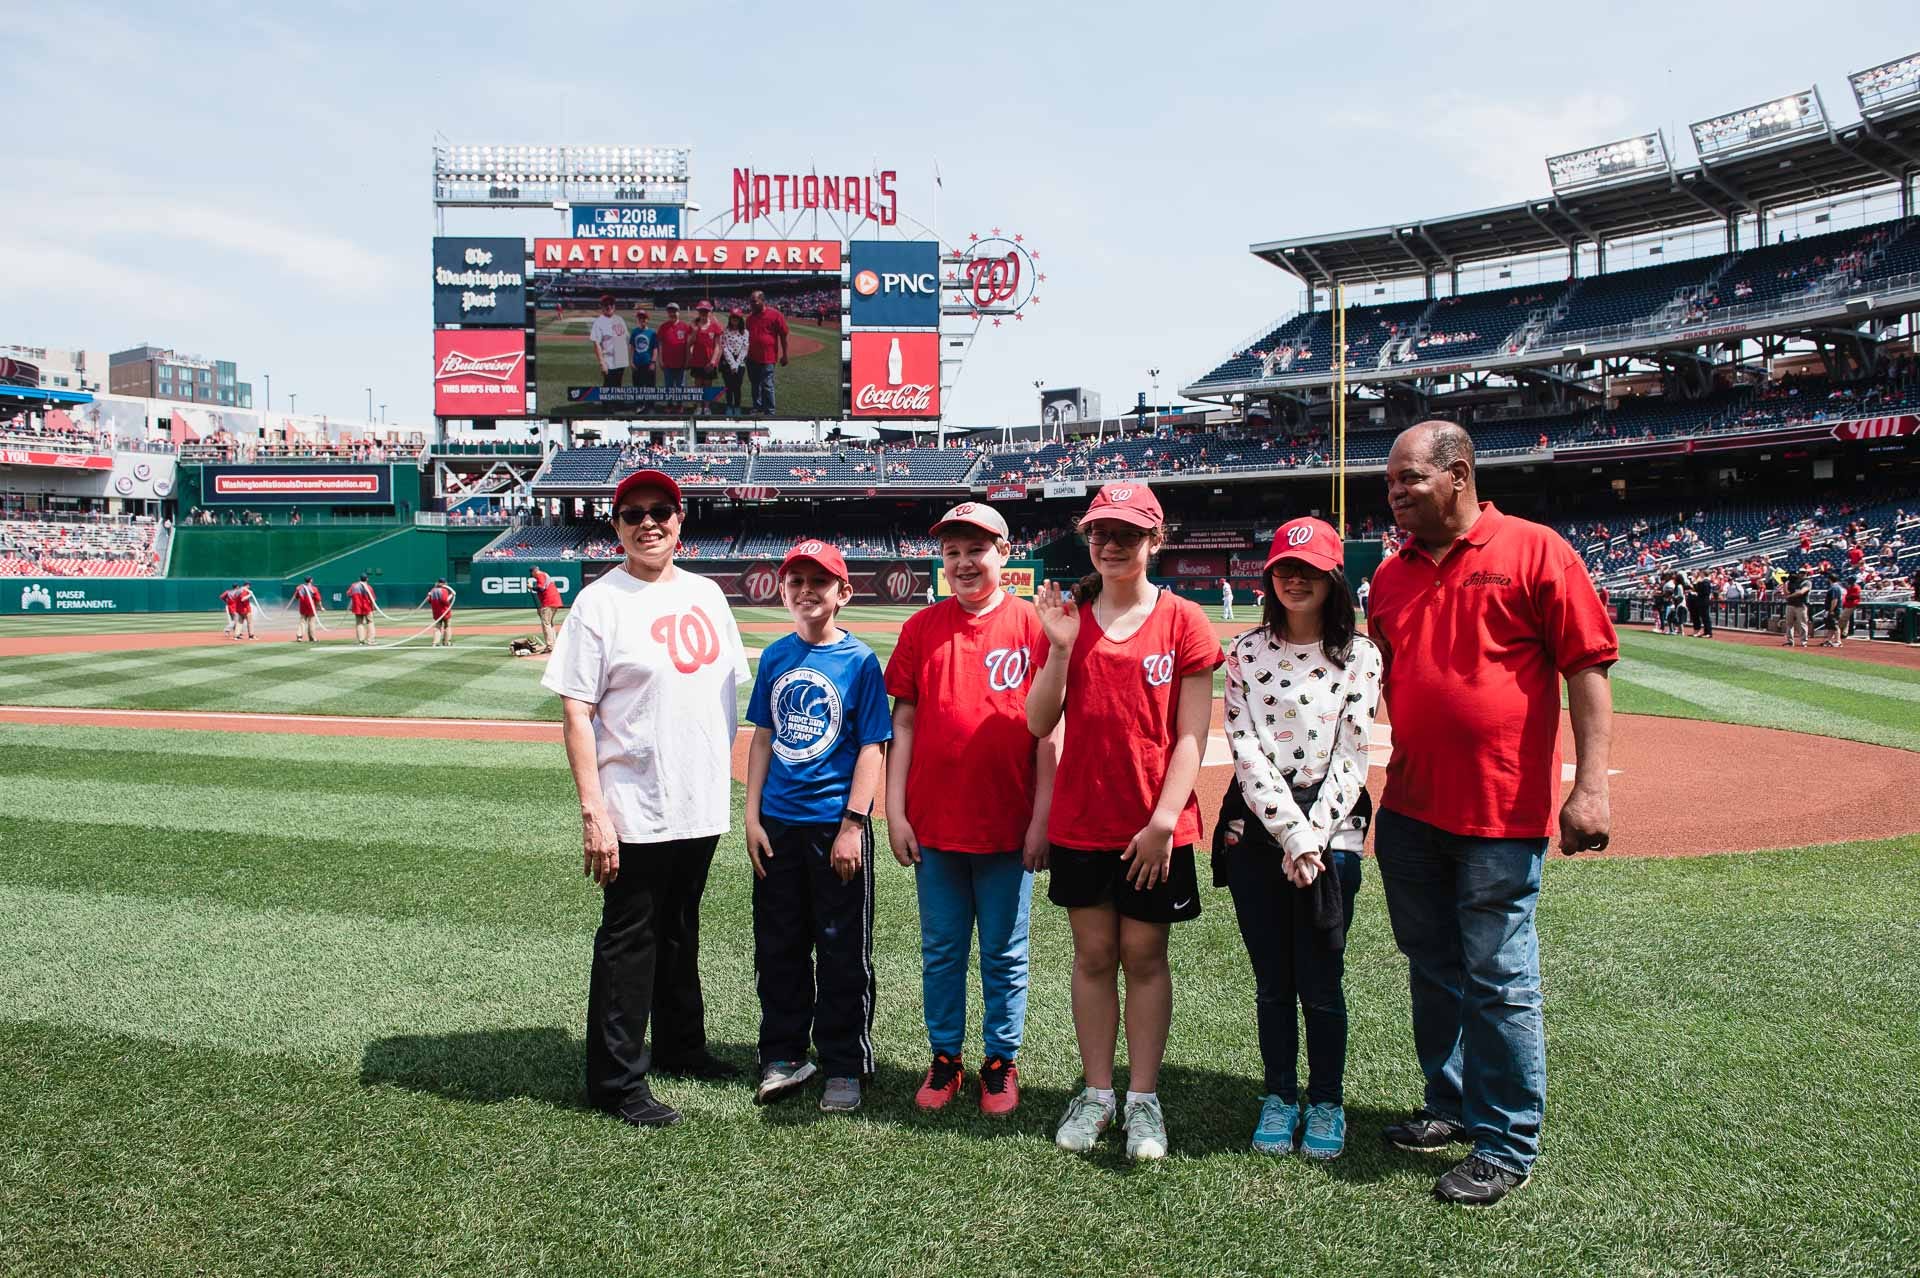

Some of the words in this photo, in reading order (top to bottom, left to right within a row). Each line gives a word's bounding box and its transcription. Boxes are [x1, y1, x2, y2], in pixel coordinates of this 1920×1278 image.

[733, 168, 897, 226] NATIONALS
[622, 209, 656, 224] 2018
[640, 224, 676, 239] GAME
[465, 248, 492, 267] The
[545, 244, 729, 263] NATIONALS
[745, 246, 825, 264] PARK
[436, 267, 522, 289] Washington
[882, 273, 935, 294] PNC
[462, 291, 496, 312] Post
[442, 357, 515, 373] Budweiser
[442, 384, 459, 394] THIS
[485, 384, 500, 394] FOR
[640, 386, 655, 394] FROM
[855, 384, 935, 410] Coca-Cola
[221, 479, 372, 490] WashingtonNationalsDreamFoundation.org
[1287, 525, 1313, 546] W
[1000, 571, 1031, 586] SON
[56, 590, 85, 599] KAISER
[650, 604, 720, 673] W
[985, 646, 1030, 691] W
[787, 722, 823, 736] BASEBALL
[788, 714, 809, 724] HOME
[808, 717, 825, 729] RUN
[793, 731, 813, 742] CAMP
